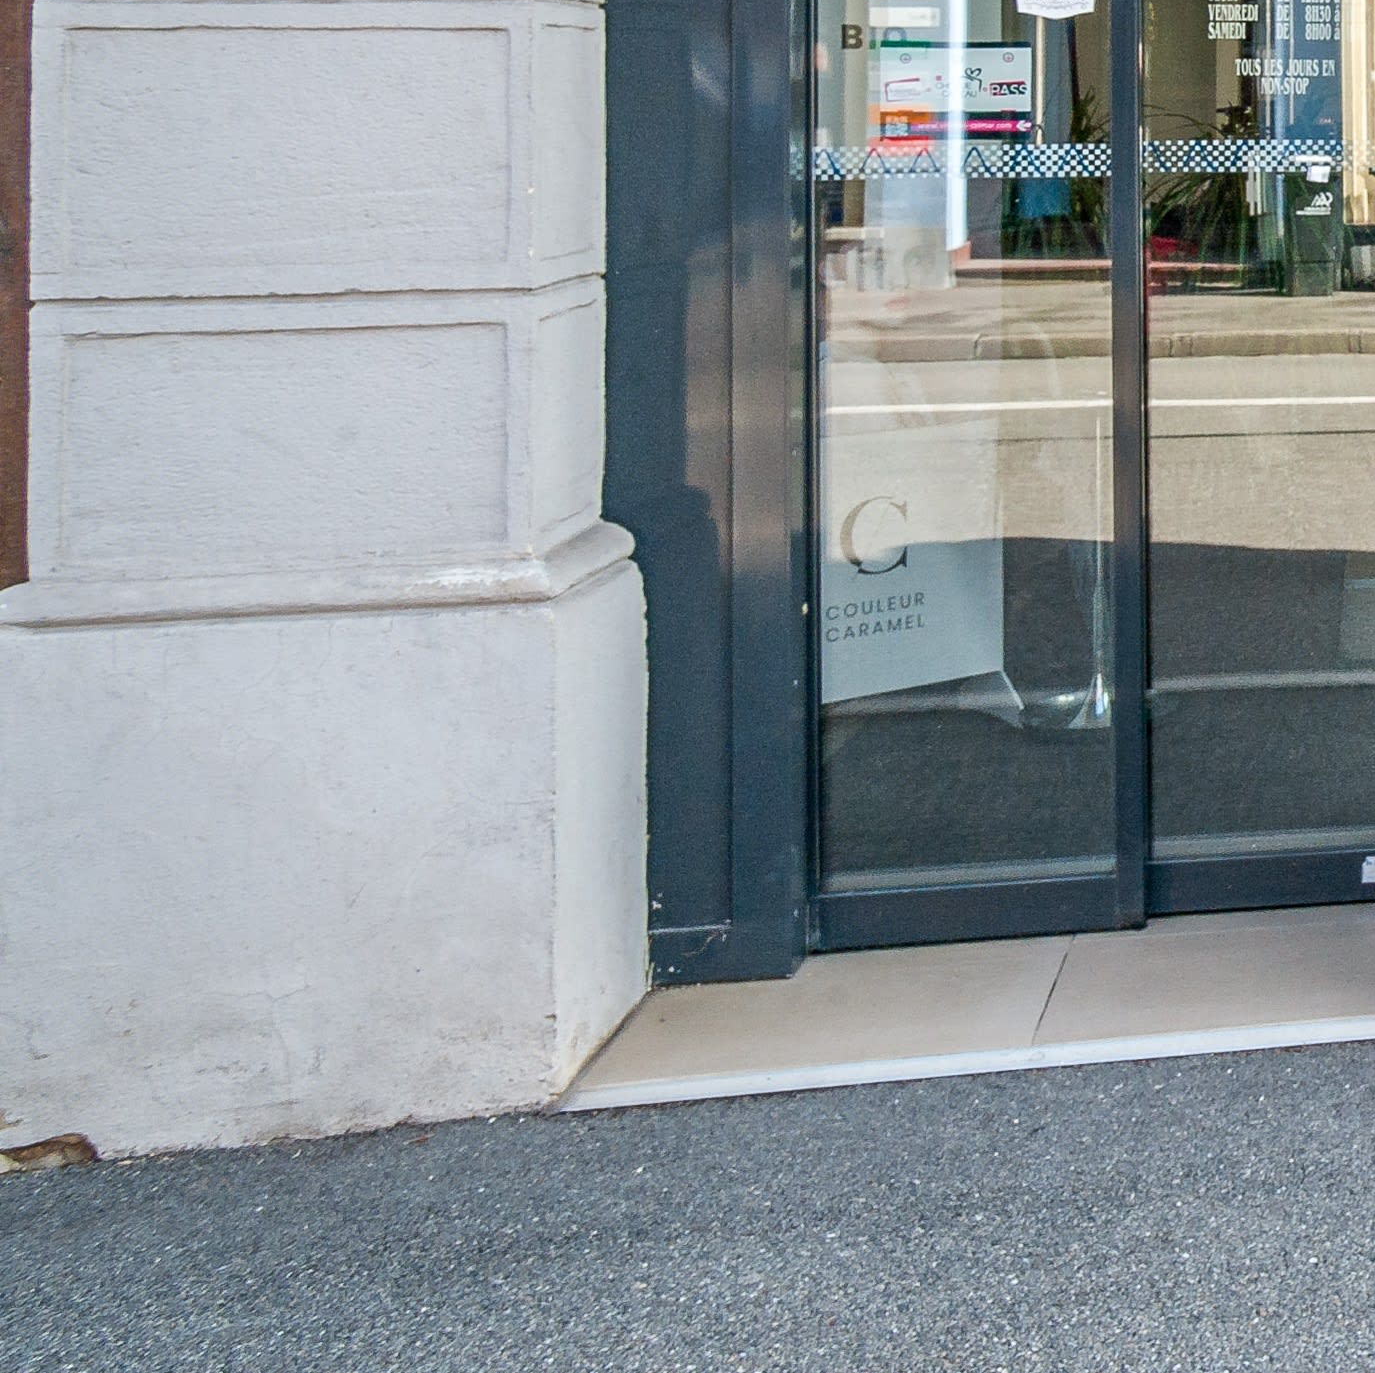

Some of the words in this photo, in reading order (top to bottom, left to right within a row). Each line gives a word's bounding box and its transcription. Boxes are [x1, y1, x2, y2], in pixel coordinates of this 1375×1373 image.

[1208, 4, 1259, 22] VENDREDI
[1277, 5, 1289, 22] DE
[1305, 4, 1332, 22] 8H30
[1208, 22, 1247, 40] SAMEDI
[1276, 23, 1289, 40] DE
[1305, 22, 1332, 40] 8H00
[1235, 59, 1261, 77] TOUS
[1264, 59, 1284, 77] LES
[1285, 59, 1320, 77] JOURS
[1322, 59, 1336, 77] EN
[1260, 77, 1310, 95] NON-STOP
[825, 591, 926, 621] COULEUR
[825, 613, 926, 643] CARAMEL
